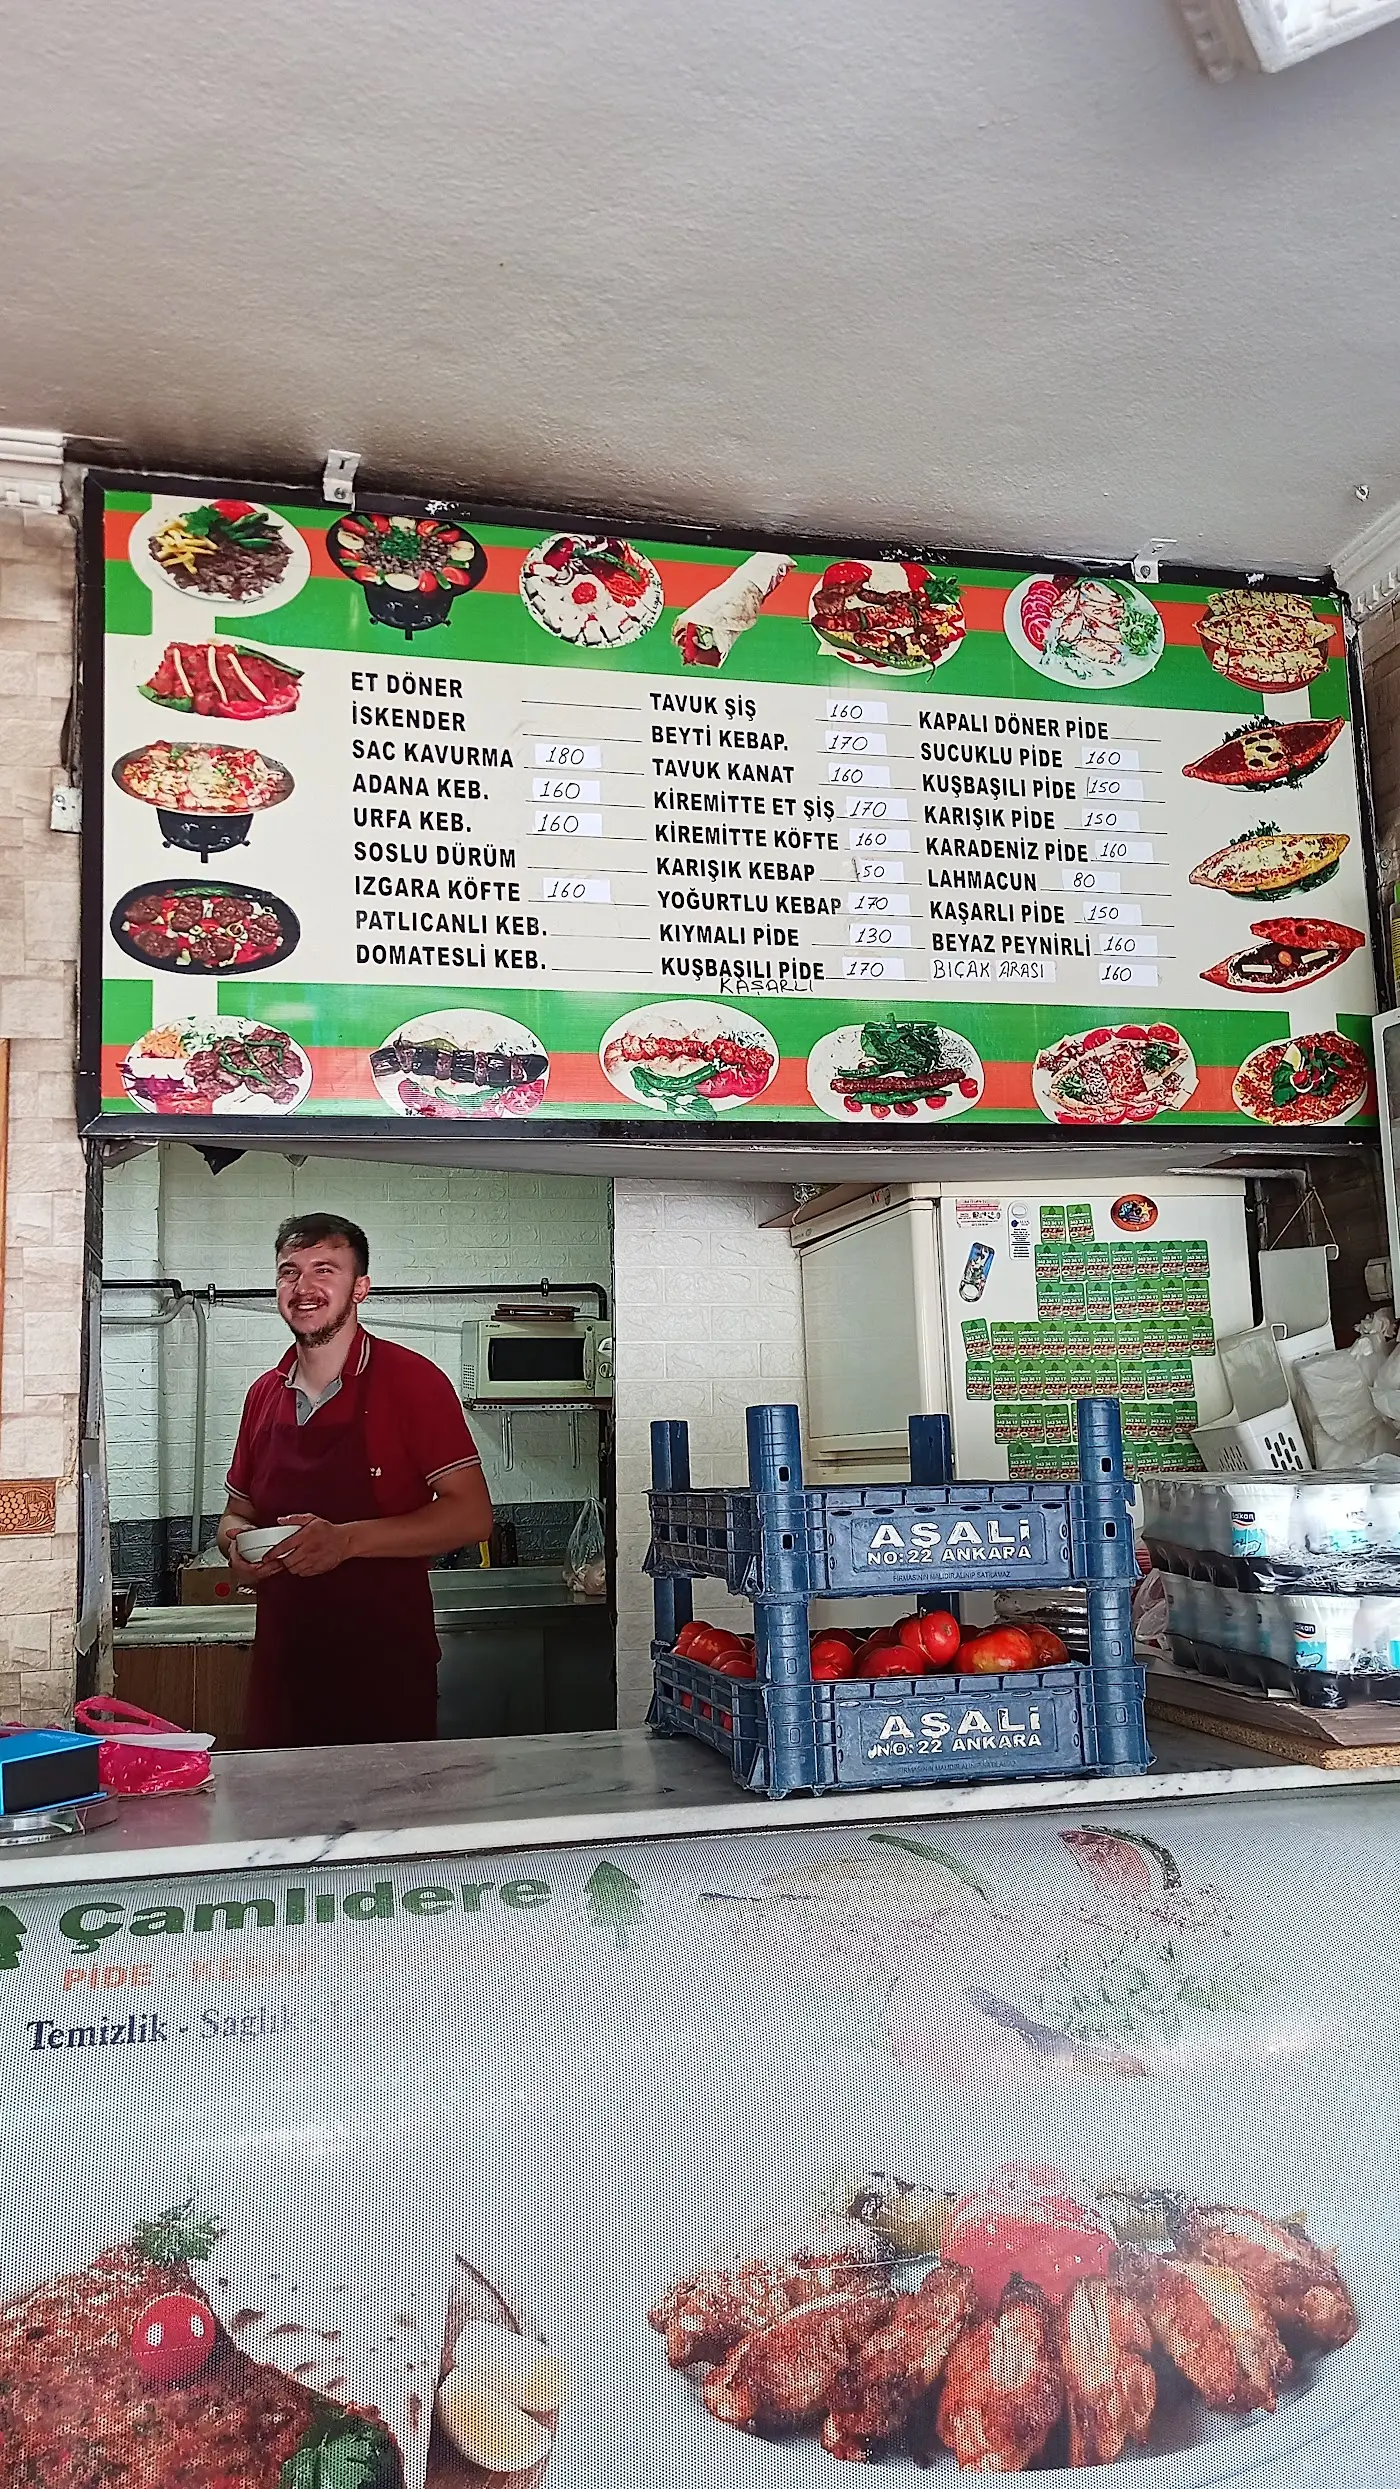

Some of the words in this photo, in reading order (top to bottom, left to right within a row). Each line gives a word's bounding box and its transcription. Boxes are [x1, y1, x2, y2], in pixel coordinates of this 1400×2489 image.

[352, 672, 378, 691] ET
[387, 672, 463, 698] DÖNER
[353, 701, 465, 731] İSKENDER
[650, 693, 718, 714] TAVUK
[725, 695, 756, 721] ŞİŞ
[830, 704, 862, 719] 160
[919, 711, 987, 732] KAPALI
[995, 713, 1060, 737] DÖNER
[1066, 720, 1108, 740] PİDE
[652, 725, 711, 746] BEYTİ
[719, 730, 788, 751] KEBAP.
[829, 735, 867, 750] 170
[353, 739, 395, 760] SAC
[405, 743, 513, 768] KAVURMA
[546, 747, 584, 764] 180
[921, 743, 1012, 765] SUCUKLU
[1020, 744, 1062, 768] PİDE
[1086, 752, 1120, 765] 160
[652, 758, 721, 779] TAVUK
[728, 763, 794, 783] KANAT
[831, 767, 863, 783] 160
[353, 774, 429, 796] ADANA
[438, 778, 488, 799] KEB.
[540, 781, 580, 799] 160
[923, 774, 1026, 800] KUŞBAŞILI
[1033, 776, 1076, 799] PİDE
[1089, 780, 1120, 793] 150
[654, 788, 765, 814] KİREMİTTE
[773, 798, 796, 815] ET
[804, 796, 834, 822] ŞİŞ
[849, 801, 886, 819] 170
[354, 807, 412, 829] URFA
[420, 811, 471, 832] KEB.
[538, 814, 578, 832] 160
[925, 806, 1005, 830] KARIŞIK
[1012, 806, 1055, 829] PİDE
[1084, 813, 1116, 826] 150
[656, 820, 766, 847] KİREMİTTE
[774, 826, 838, 850] KÖFTE
[856, 833, 886, 846] 160
[354, 842, 427, 863] SOSLU
[437, 842, 515, 868] DÜRÜM
[926, 837, 1039, 860] KARADENİZ
[1045, 837, 1088, 862] PİDE
[1100, 843, 1126, 858] 160
[657, 857, 742, 882] KARIŞIK
[749, 862, 814, 881] KEBAP
[928, 869, 1036, 891] LAHMACUN
[1074, 872, 1095, 887] 80
[356, 876, 440, 898] IZGARA
[449, 876, 520, 901] KÖFTE
[548, 882, 585, 898] 160
[658, 888, 768, 912] YOĞURTLU
[855, 896, 888, 910] 170
[930, 901, 1014, 925] KAŞARLI
[1022, 901, 1064, 924] PİDE
[1087, 906, 1118, 920] 150
[356, 910, 486, 933] PATLICANLI
[496, 916, 546, 936] KEB.
[660, 924, 745, 944] KIYMALI
[754, 924, 799, 946] PİDE
[855, 928, 891, 943] 130
[932, 933, 995, 953] BEYAZ
[1002, 933, 1090, 956] PEYNİRLİ
[1104, 936, 1135, 952] 160
[357, 944, 485, 967] DOMATESLİ
[495, 949, 545, 969] KEB.
[662, 957, 771, 982] KUŞBAŞILI
[779, 957, 824, 980] PİDE
[847, 962, 884, 977] 170
[934, 960, 989, 978] BIÇAK
[999, 961, 1043, 978] ARASI
[1102, 965, 1131, 981] 160
[720, 978, 813, 995] KAŞARLI
[867, 1549, 933, 1566] NO:22
[941, 1545, 1032, 1562] ANKARA
[875, 1740, 943, 1758] NO:22
[952, 1735, 1042, 1752] ANKARA
[59, 1879, 552, 1954] Çamlıdere
[62, 1962, 153, 1992] PİDE
[26, 2012, 169, 2051] Temizlik
[198, 2005, 298, 2042] Sağlık
